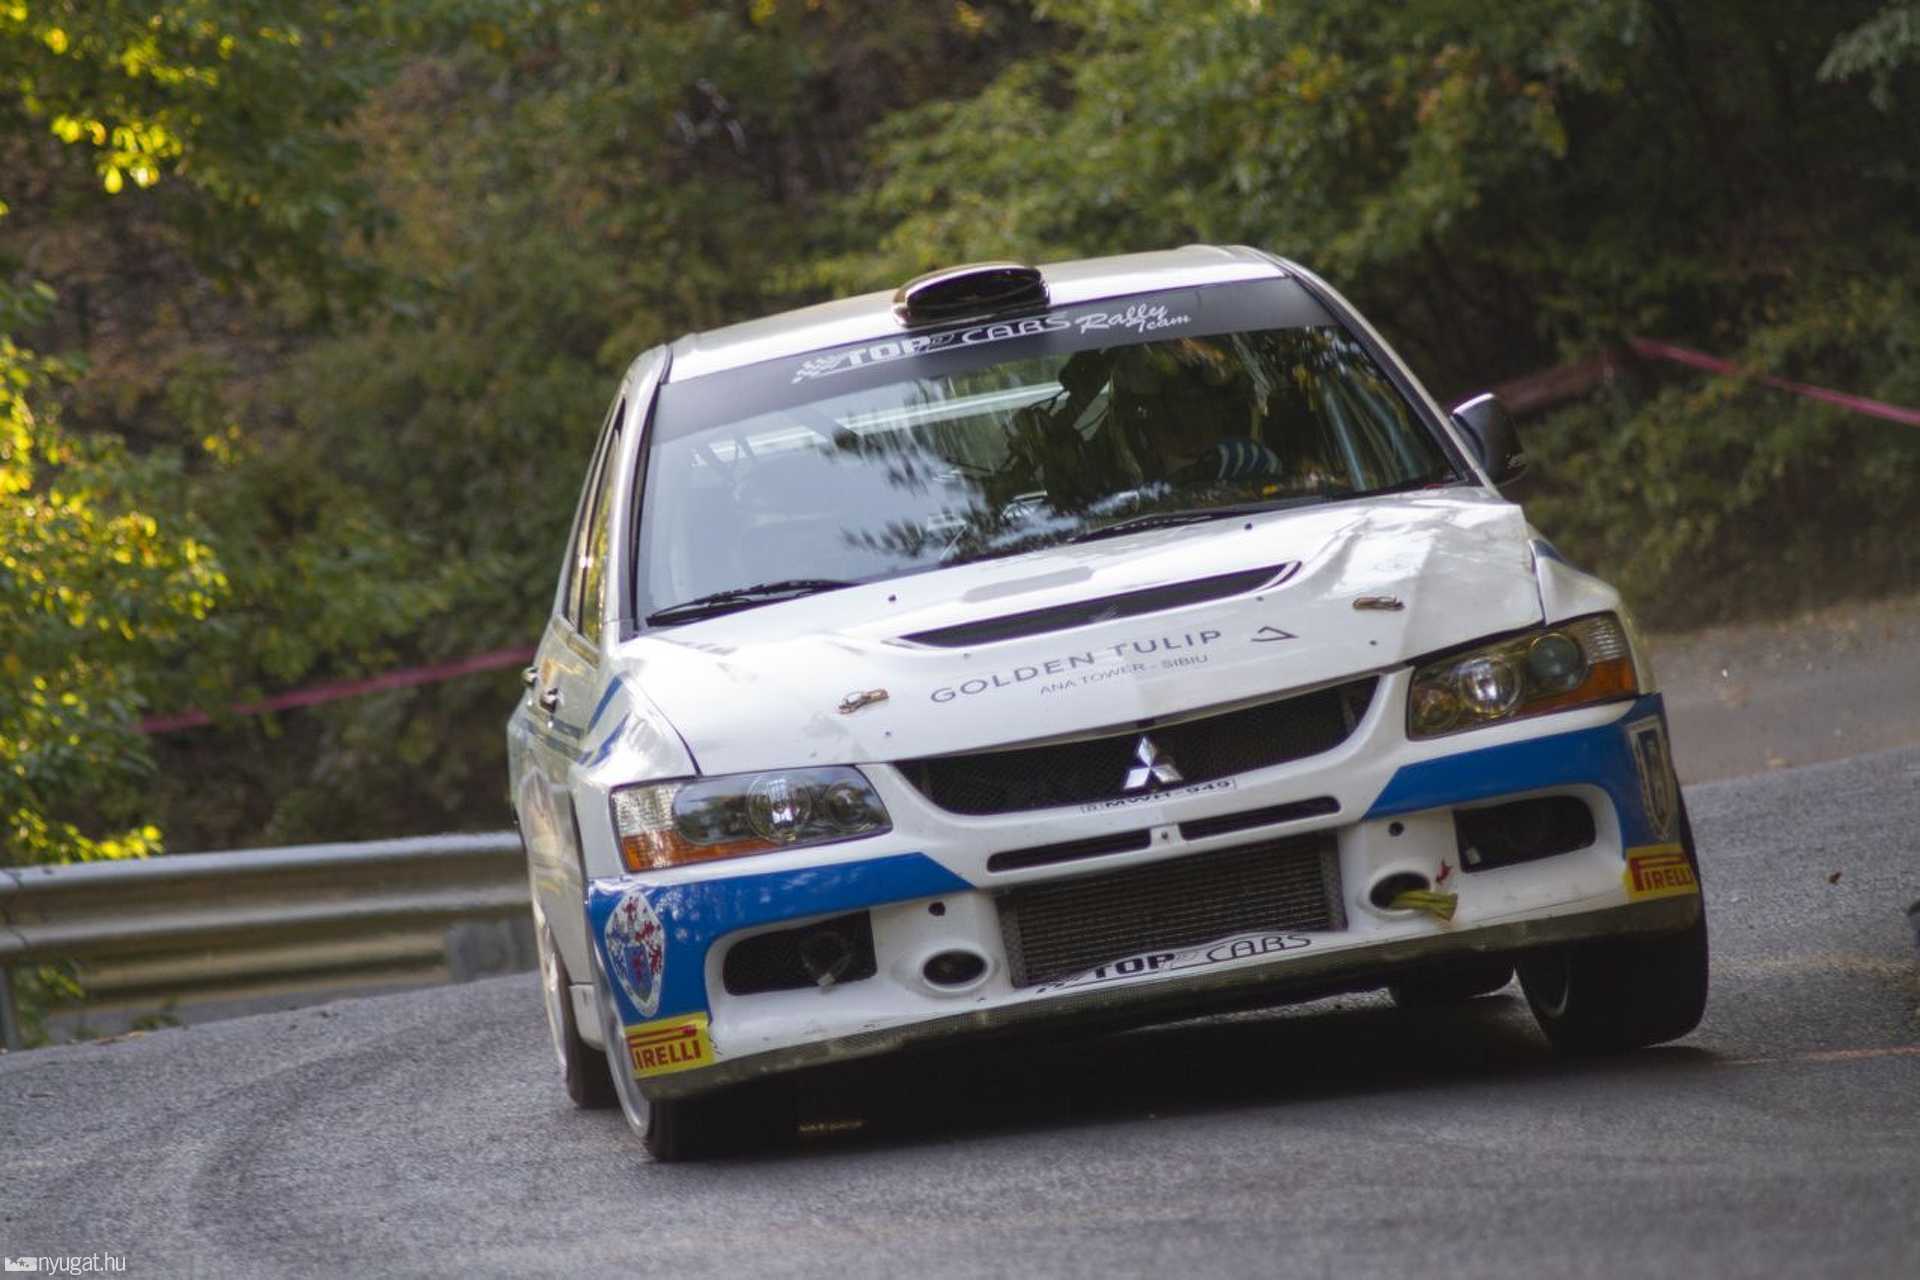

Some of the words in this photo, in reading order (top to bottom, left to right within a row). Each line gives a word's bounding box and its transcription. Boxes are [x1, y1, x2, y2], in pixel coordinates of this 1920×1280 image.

[848, 336, 931, 367] TOP
[961, 312, 1071, 344] CARS
[1074, 303, 1169, 334] Rally
[1134, 315, 1192, 333] Team
[930, 652, 1095, 703] GOLDEN
[1104, 630, 1222, 658] TULIP
[1040, 679, 1077, 695] ANA
[1082, 663, 1146, 683] TOWER
[1162, 654, 1209, 671] SIBIU
[1095, 952, 1175, 979] TOP
[1206, 934, 1312, 962] CARS
